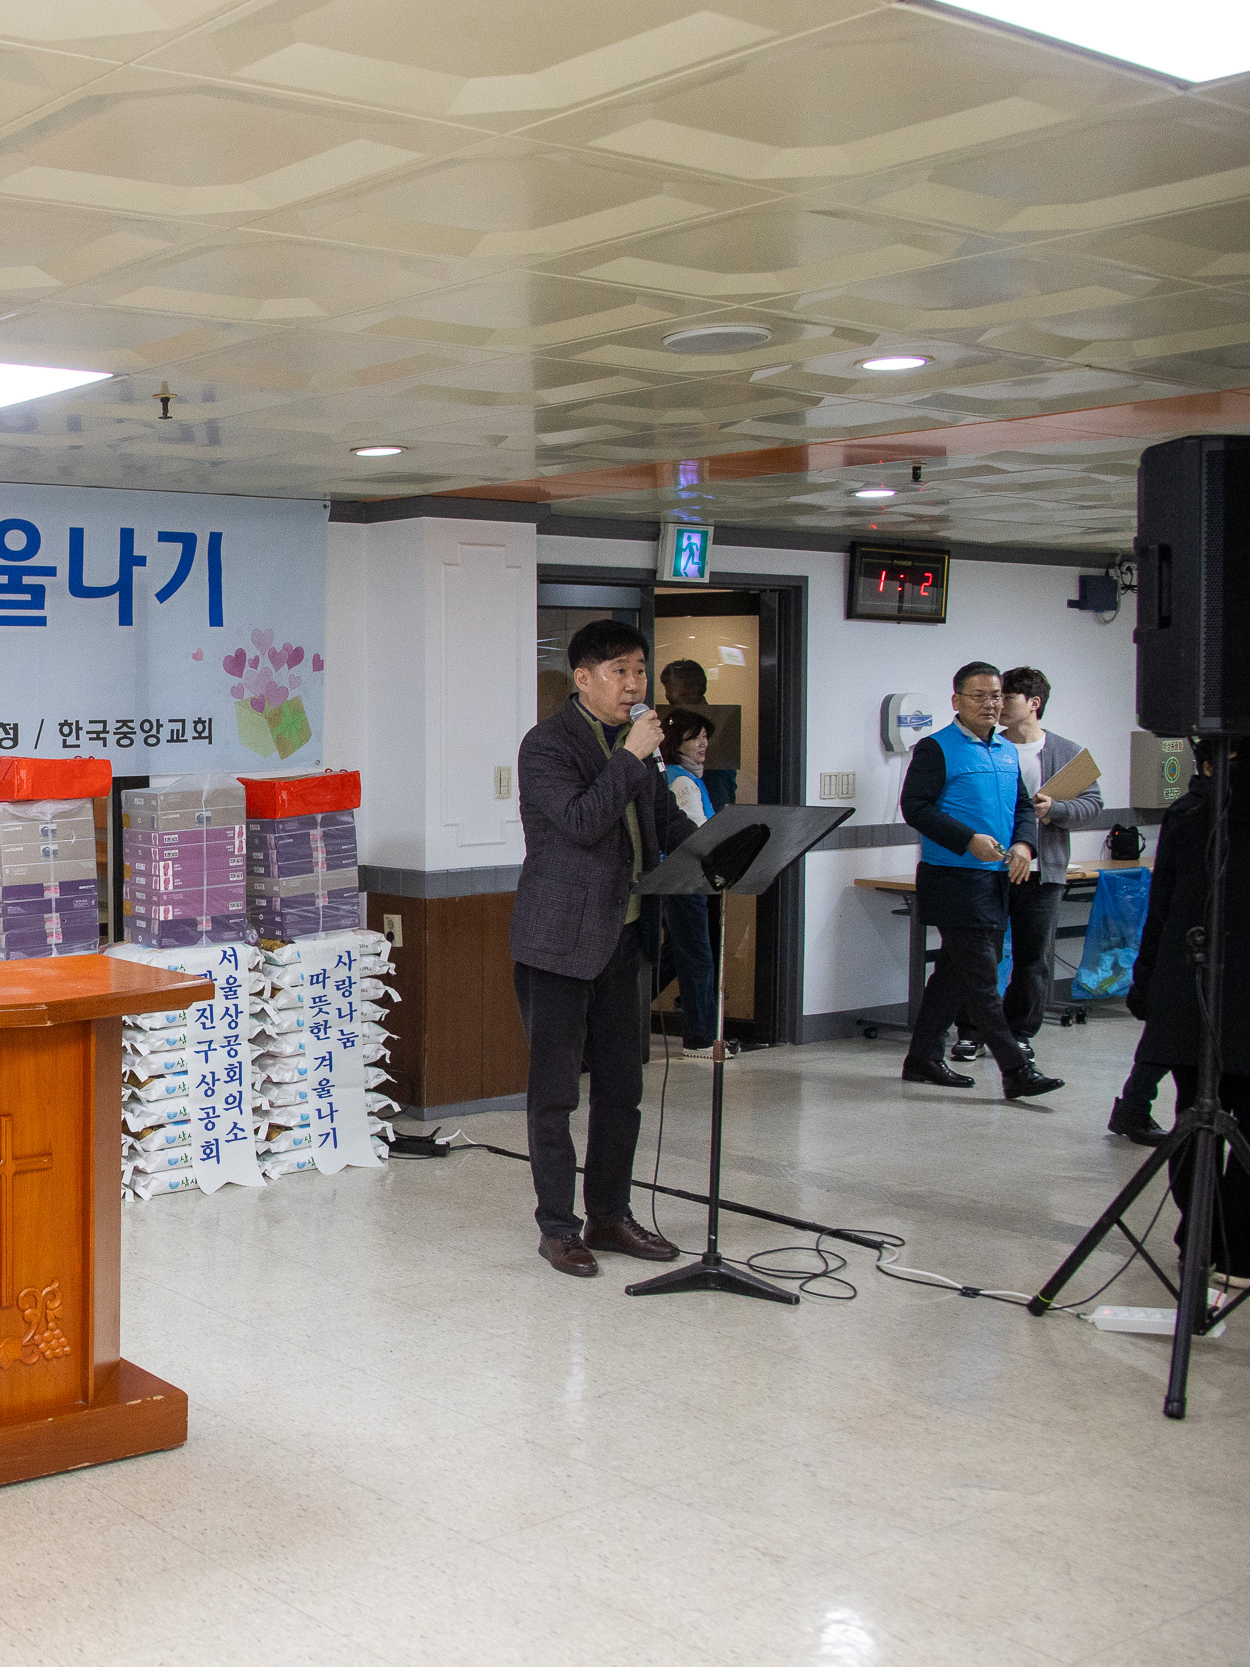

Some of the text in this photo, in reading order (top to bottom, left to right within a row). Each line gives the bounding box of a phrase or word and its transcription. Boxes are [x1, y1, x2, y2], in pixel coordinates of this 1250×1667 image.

[57, 716, 214, 750] 한국중앙교회
[218, 946, 249, 1144] 서울상공회의소
[308, 968, 339, 1149] 따뜻한 겨울나기
[333, 950, 360, 1050] 사랑나눔
